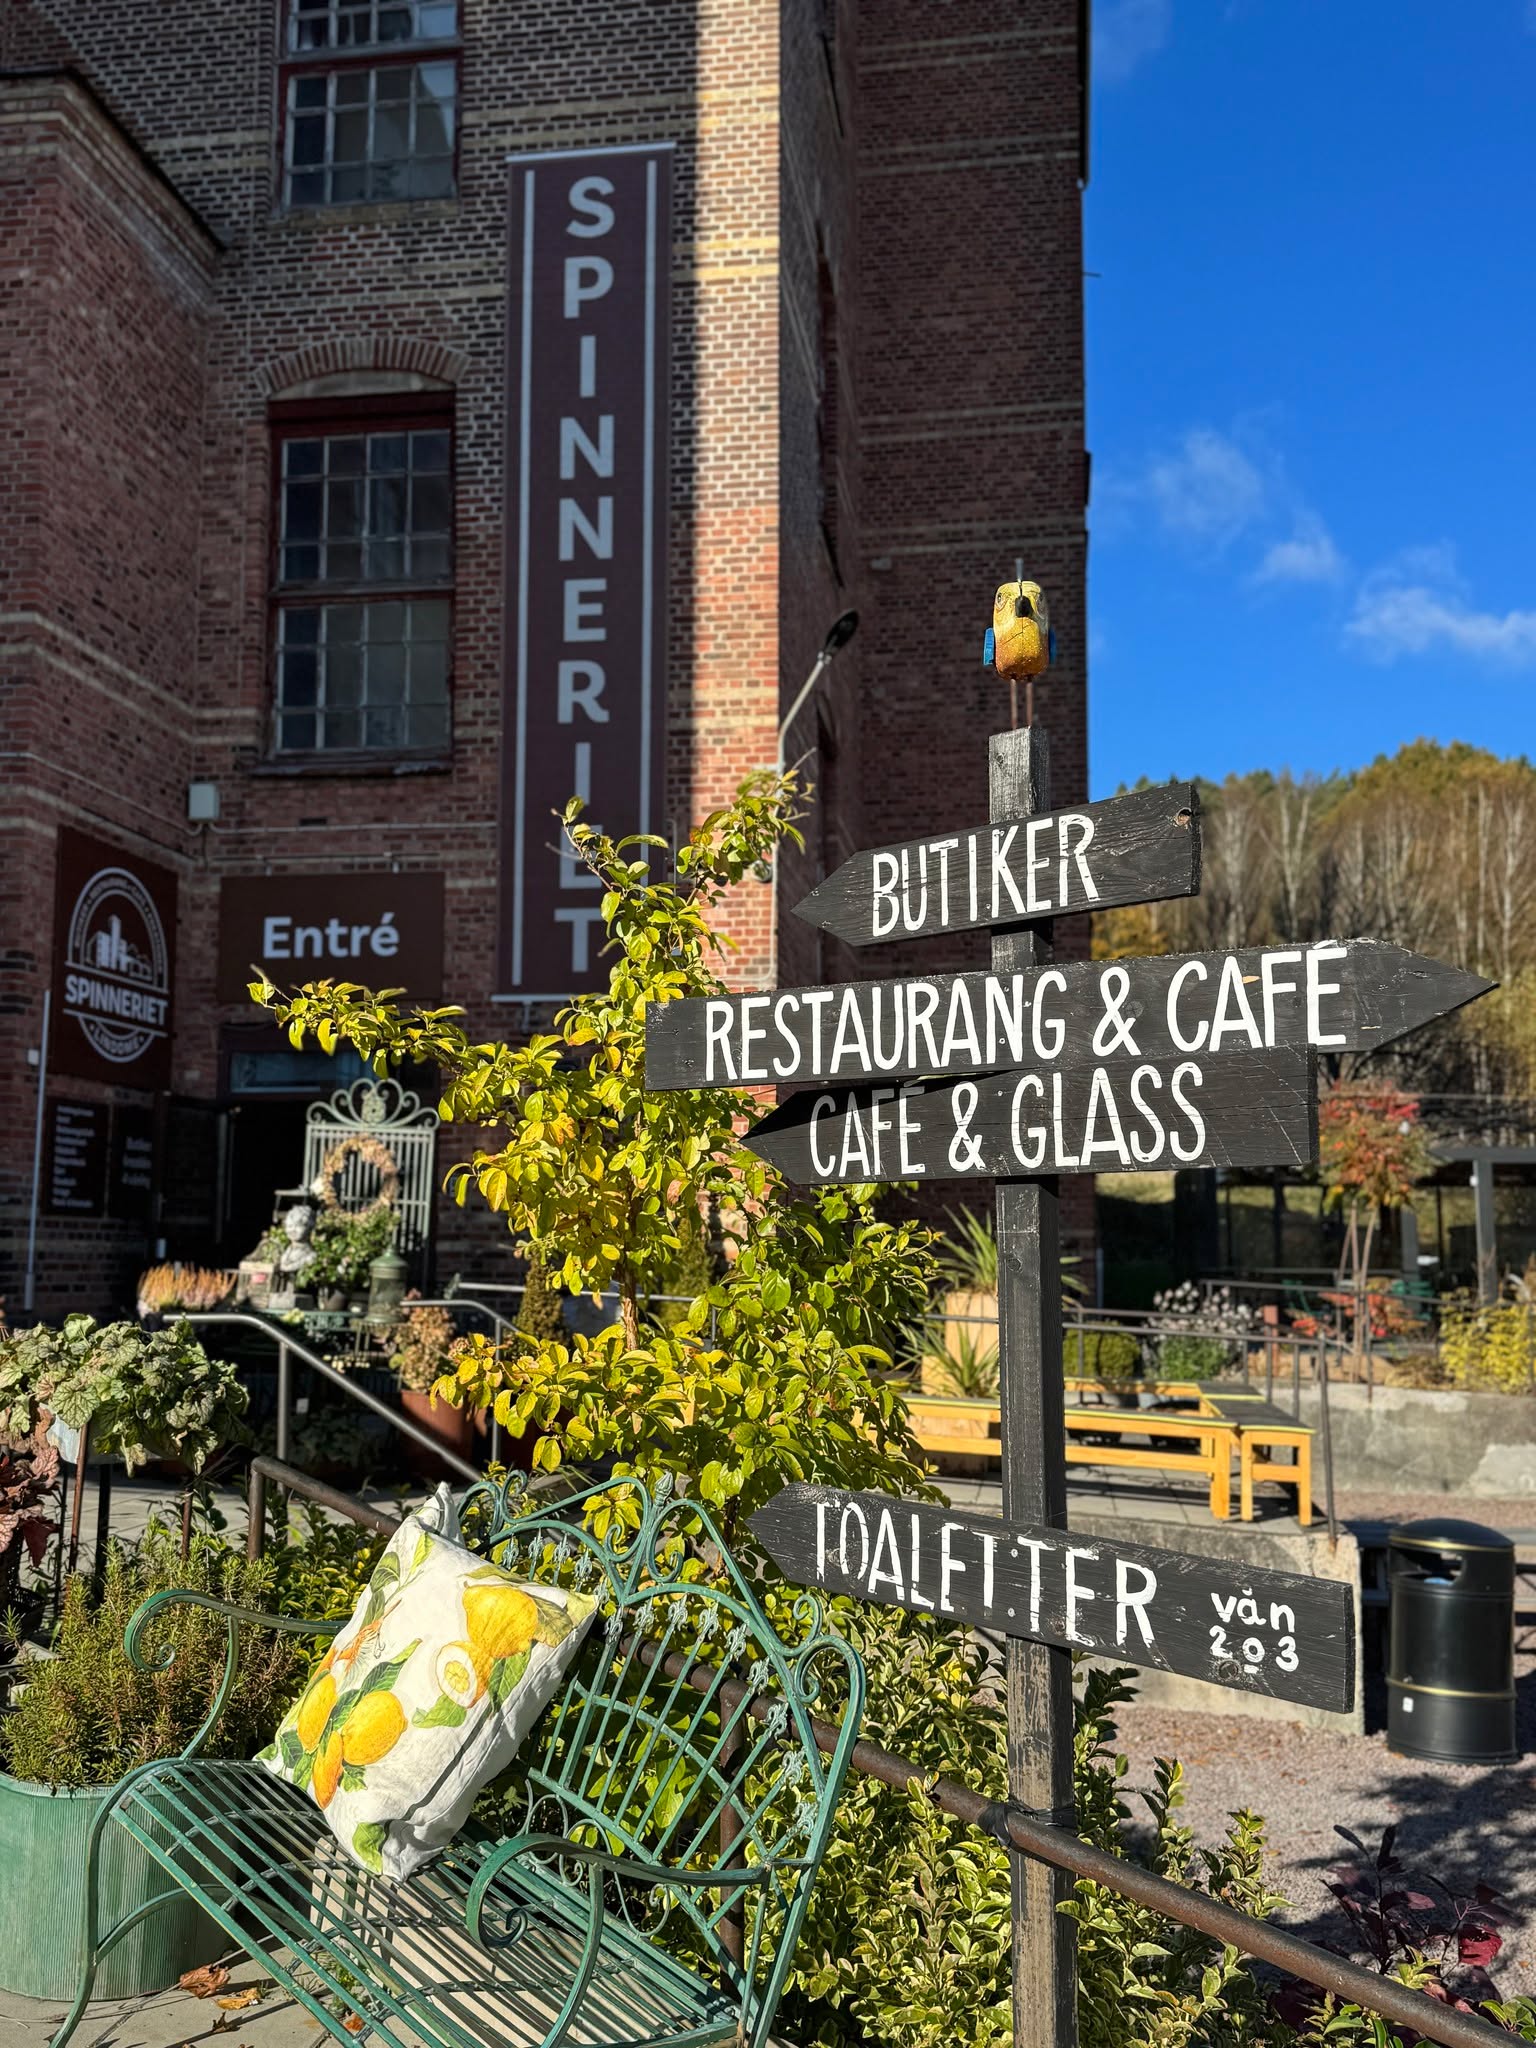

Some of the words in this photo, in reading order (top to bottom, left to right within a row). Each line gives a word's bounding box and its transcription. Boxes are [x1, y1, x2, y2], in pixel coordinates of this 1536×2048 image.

[554, 173, 615, 973] SPINNERIET
[263, 912, 399, 959] Entré
[872, 813, 1099, 938] BUTIKER
[64, 974, 168, 1026] SPINNERIET
[705, 969, 1067, 1083] RESTAURANG
[1092, 966, 1143, 1057] &
[1166, 939, 1349, 1054] CAFÉ
[810, 1079, 926, 1178] CAFÉ
[948, 1081, 987, 1173] &
[1011, 1060, 1207, 1168] GLASS
[814, 1501, 1158, 1649] TOALETTER
